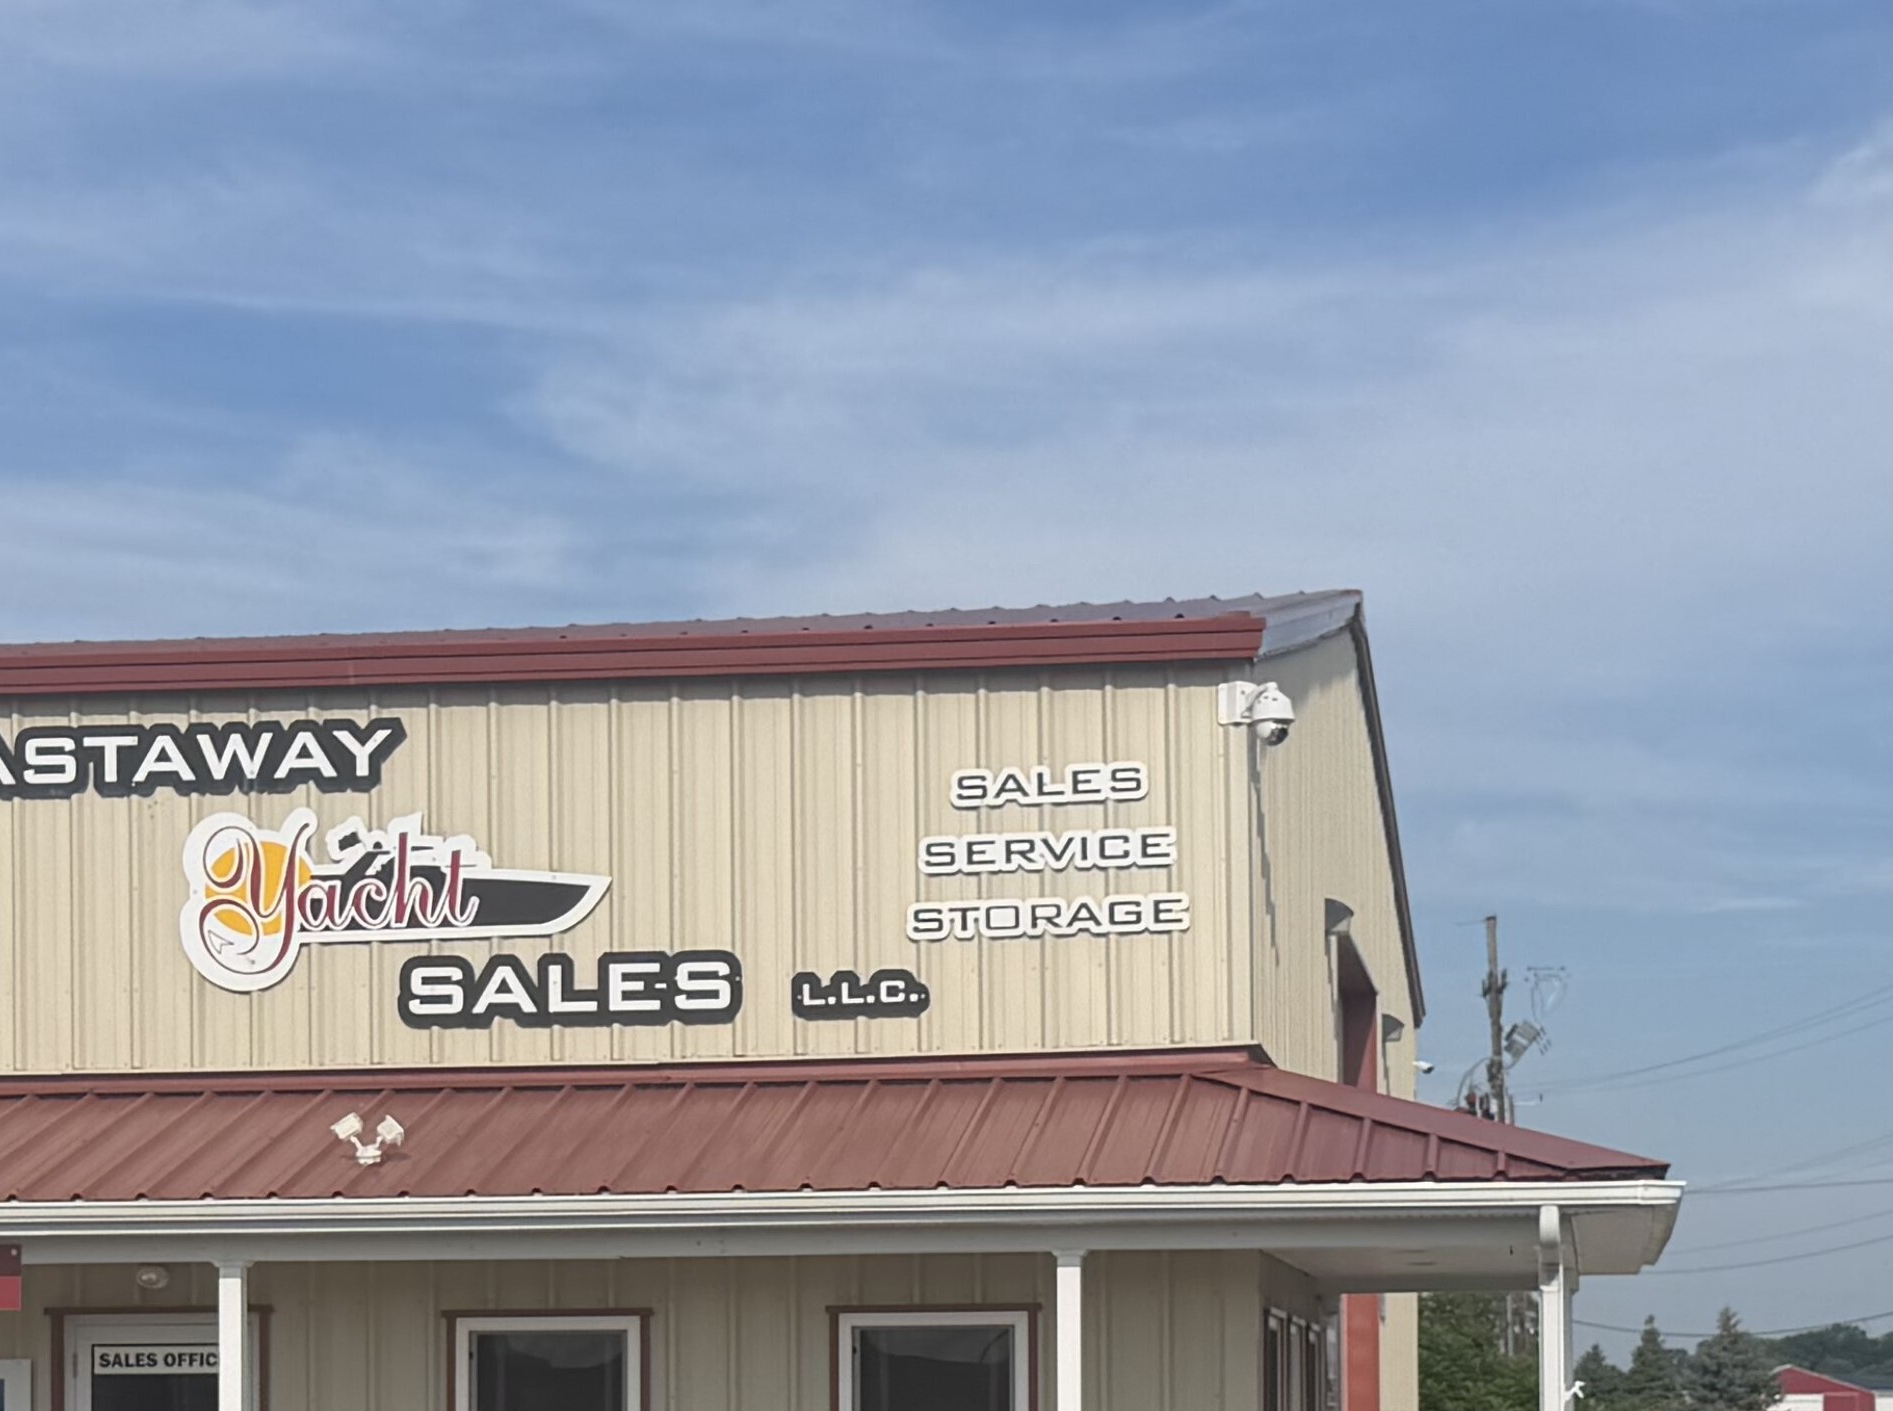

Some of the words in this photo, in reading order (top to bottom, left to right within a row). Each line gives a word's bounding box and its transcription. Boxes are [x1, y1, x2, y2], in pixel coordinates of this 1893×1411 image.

[955, 765, 1143, 801] SALES
[924, 831, 1173, 868] SERVICE
[197, 820, 480, 975] Yacht
[912, 896, 1189, 935] STORAGE
[408, 960, 734, 1017] SALES
[802, 980, 919, 1006] L.L.C.
[99, 1352, 158, 1368] SALES
[163, 1352, 219, 1368] OFFIC
